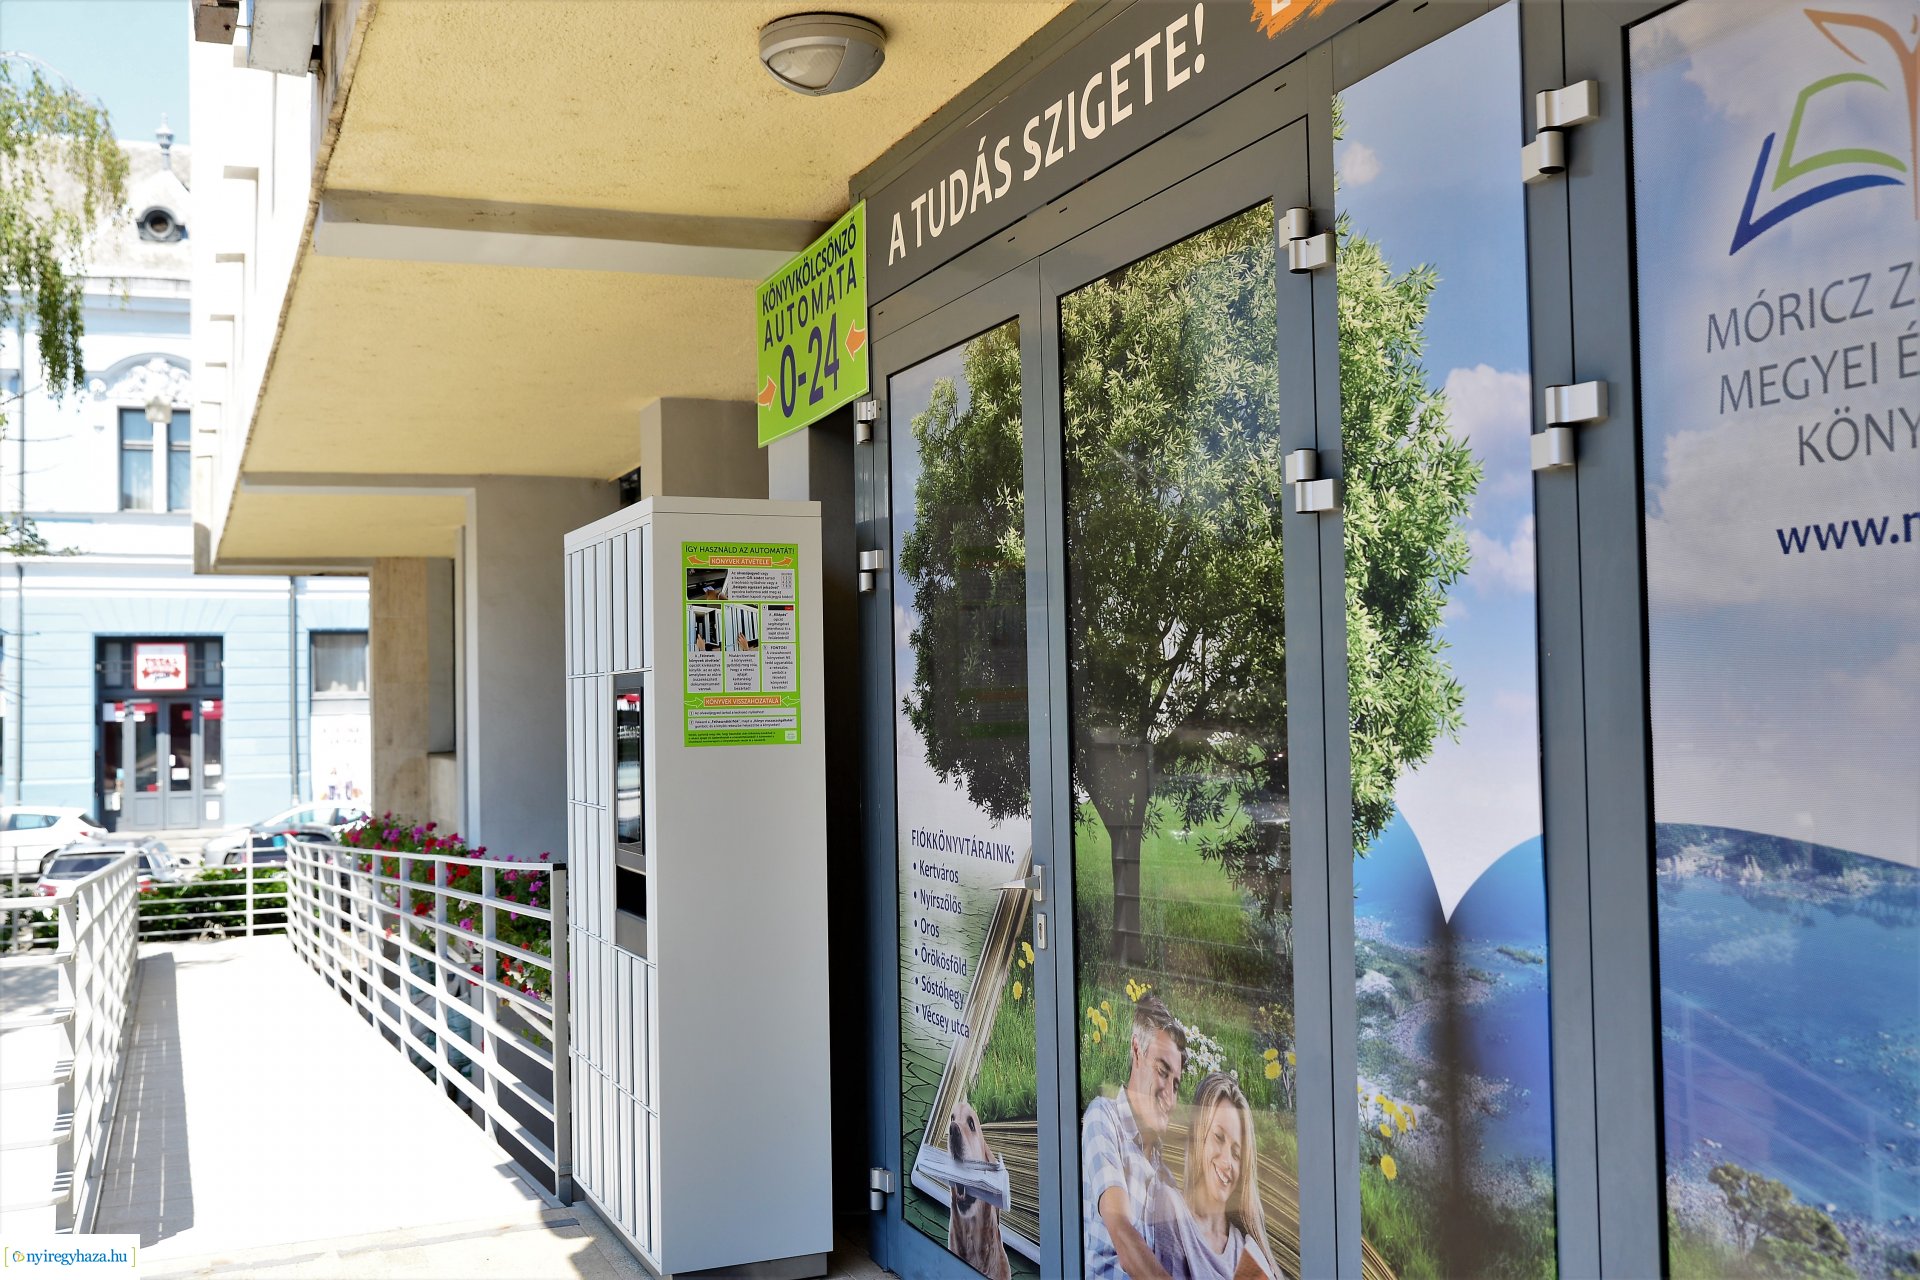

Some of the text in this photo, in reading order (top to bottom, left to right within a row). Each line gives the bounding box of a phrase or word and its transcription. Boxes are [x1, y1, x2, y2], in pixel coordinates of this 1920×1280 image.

[888, 2, 1205, 267] A TUDÁS SZIGETE!
[762, 216, 857, 317] KÖNYVKÖLCSÖNZŐ
[764, 257, 857, 353] AUTOMATA
[1707, 261, 1920, 354] MÓRICZ Z
[780, 312, 839, 418] 0-24
[1720, 341, 1878, 415] MEGYEI
[1798, 405, 1920, 466] KÖNY
[699, 545, 738, 554] HASZNÁLD
[739, 547, 749, 555] AZ
[749, 546, 795, 556] AUTOMATÁT!
[705, 696, 779, 706] KÖNYVEK VISSZAHOZATALA
[911, 826, 1015, 865] FIÓKKÖNYVTÁRAINK:
[919, 859, 959, 884] Kertváros
[920, 889, 962, 915] Nyírszőlős
[920, 919, 940, 938] Oros
[921, 943, 967, 977] Örökösföld
[921, 974, 965, 1011] Sóstóhegy
[922, 1004, 970, 1039] Vécsey utca
